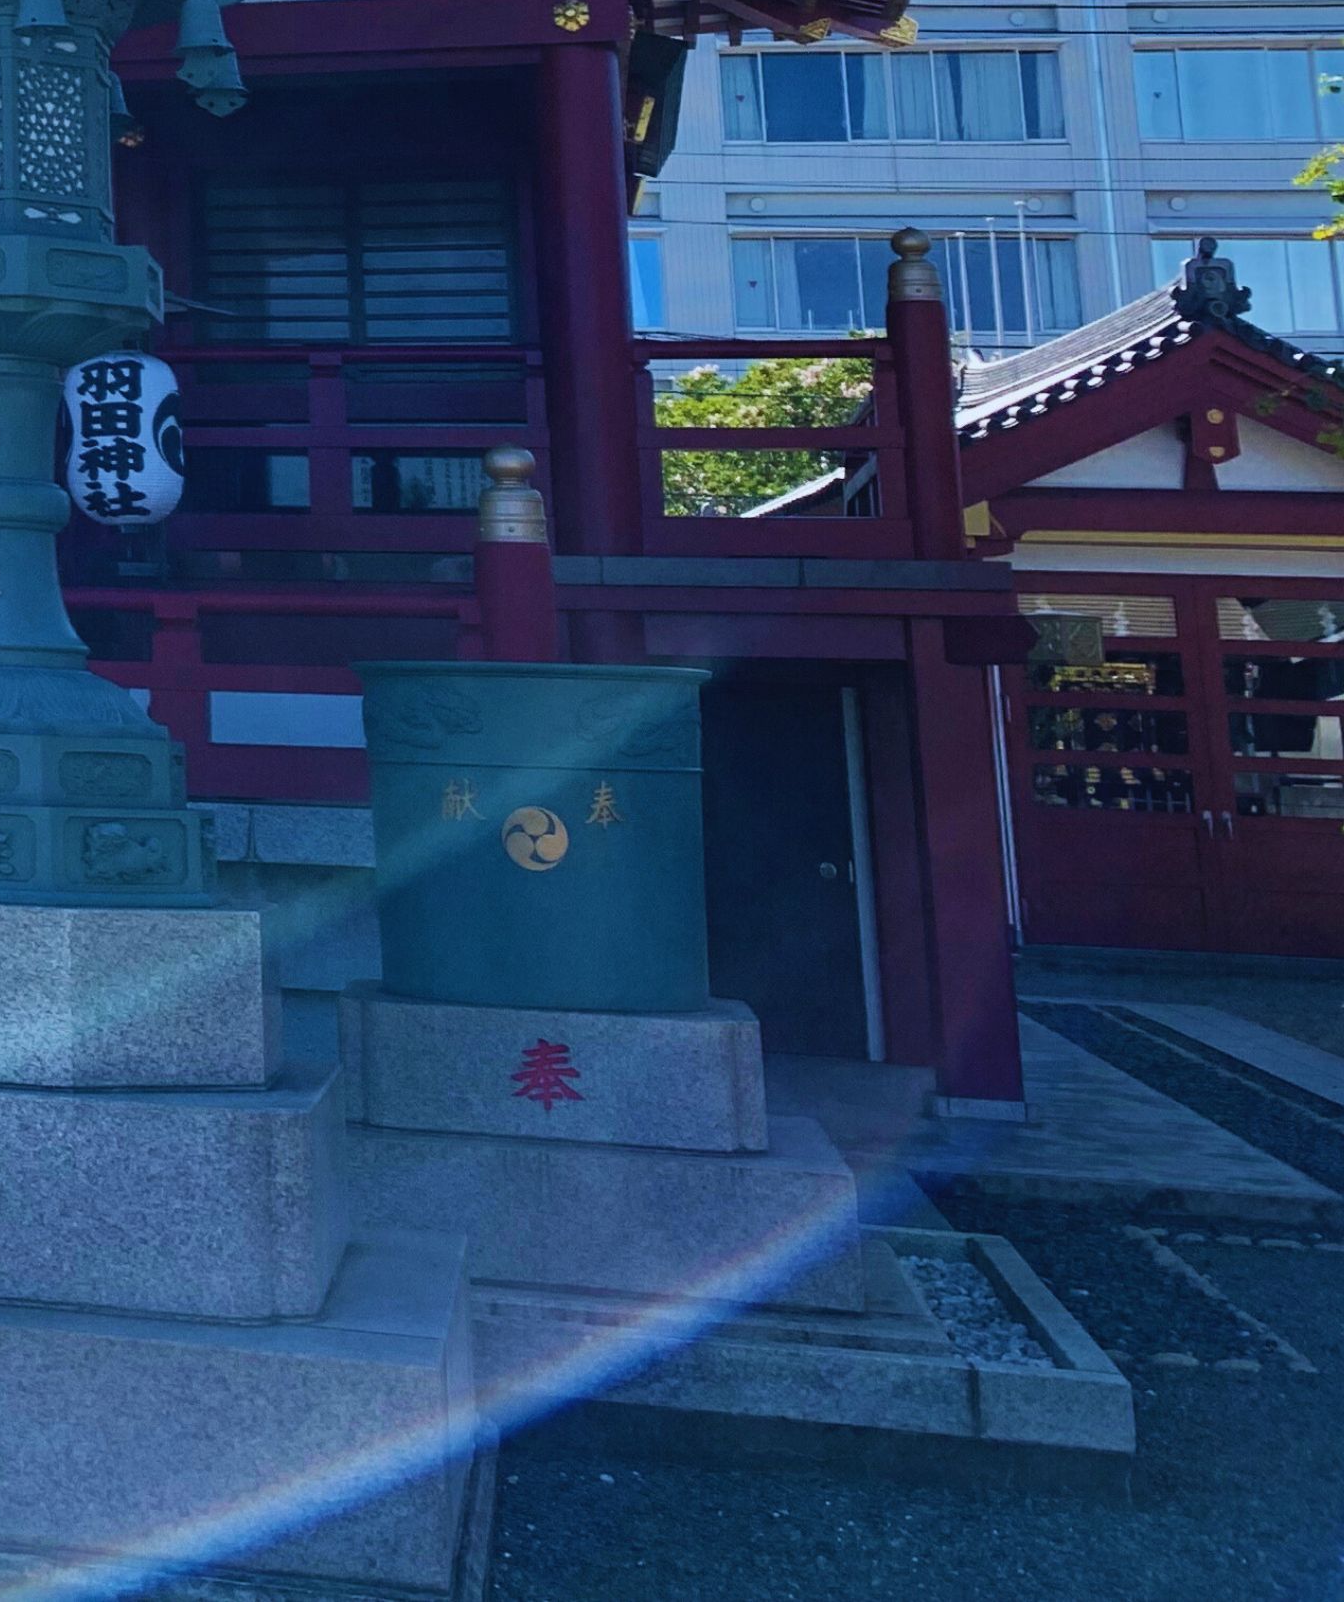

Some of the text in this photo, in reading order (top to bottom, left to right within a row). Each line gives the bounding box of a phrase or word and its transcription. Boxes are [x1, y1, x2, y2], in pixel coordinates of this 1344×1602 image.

[76, 359, 151, 518] 羽田神社
[442, 778, 625, 830] 奉 献
[509, 1038, 585, 1111] 奉
